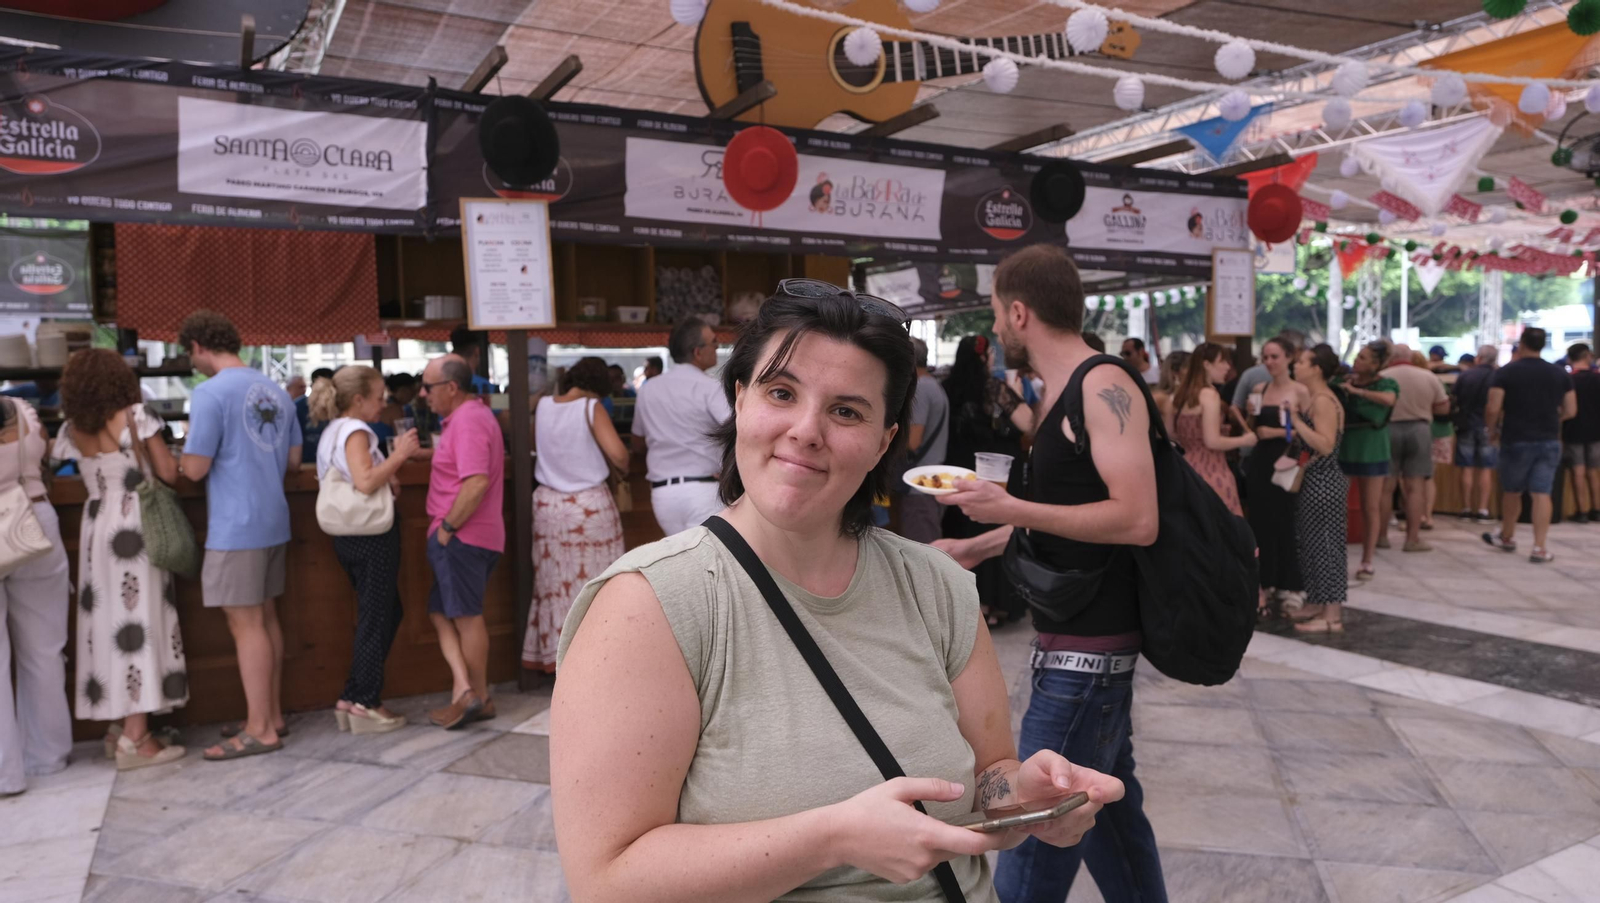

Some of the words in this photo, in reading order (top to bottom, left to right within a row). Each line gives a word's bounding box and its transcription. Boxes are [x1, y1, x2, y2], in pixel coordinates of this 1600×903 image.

[132, 70, 168, 82] CONTIGO
[216, 79, 227, 89] DE
[0, 115, 79, 141] Estrella
[0, 134, 76, 160] Galicia
[214, 135, 289, 162] SANTA
[324, 144, 393, 172] CLARA
[67, 196, 79, 204] YO
[136, 200, 172, 211] CONTIGO
[191, 203, 214, 215] FERIA
[215, 206, 225, 216] DE
[834, 199, 925, 222] BURANA
[1050, 654, 1122, 671] INFINIE
